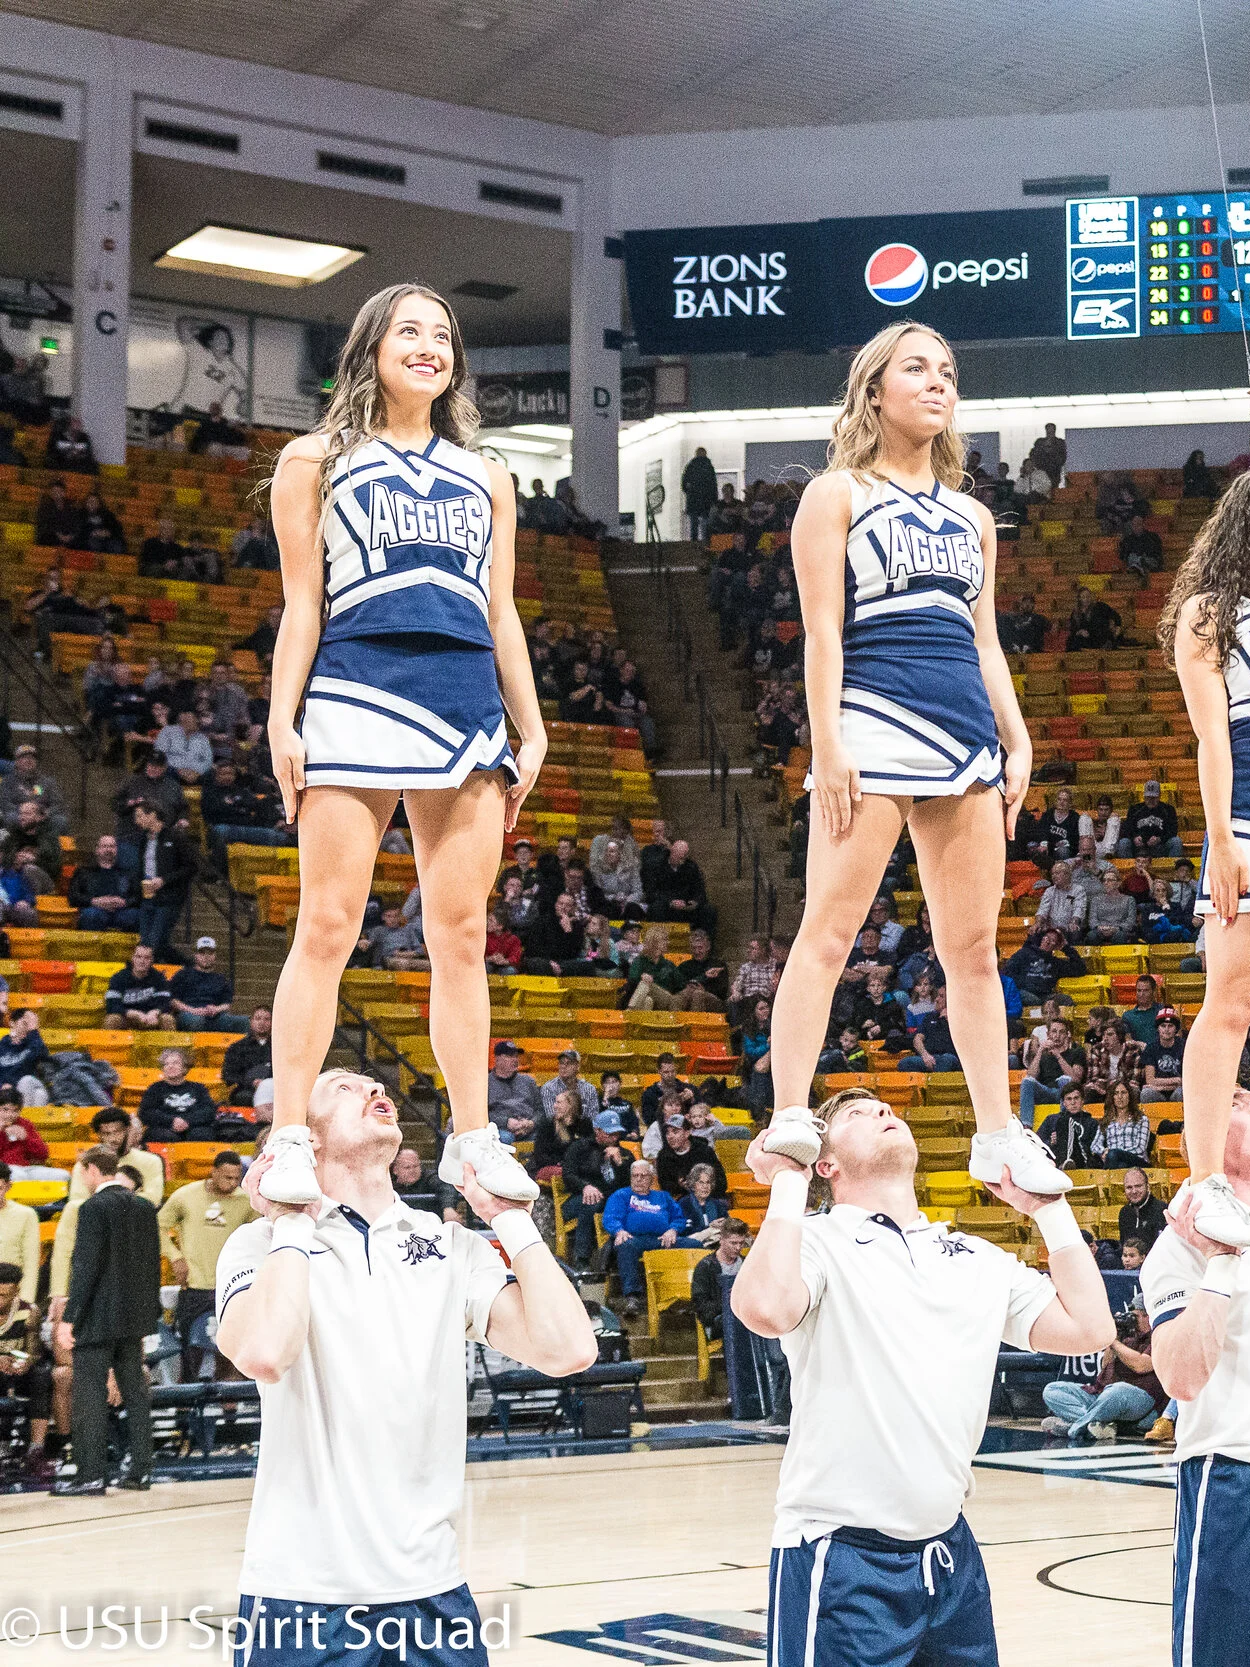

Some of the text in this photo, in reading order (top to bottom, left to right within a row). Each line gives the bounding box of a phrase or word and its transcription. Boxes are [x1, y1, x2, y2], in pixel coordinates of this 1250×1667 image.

[1202, 219, 1211, 233] 1
[1178, 242, 1190, 257] 2
[1201, 241, 1212, 256] 0
[673, 252, 786, 285] ZIONS
[933, 252, 1029, 289] pepsi
[1149, 263, 1212, 281] 22 3 0
[673, 285, 785, 319] BANK
[1150, 285, 1213, 303] 24 3 0
[95, 310, 117, 335] C
[1073, 298, 1134, 324] EK
[1150, 308, 1213, 325] 34 4 0
[593, 386, 611, 408] D
[369, 481, 487, 559] AGGIES
[888, 518, 984, 591] AGGIES
[1167, 1290, 1186, 1302] STATE
